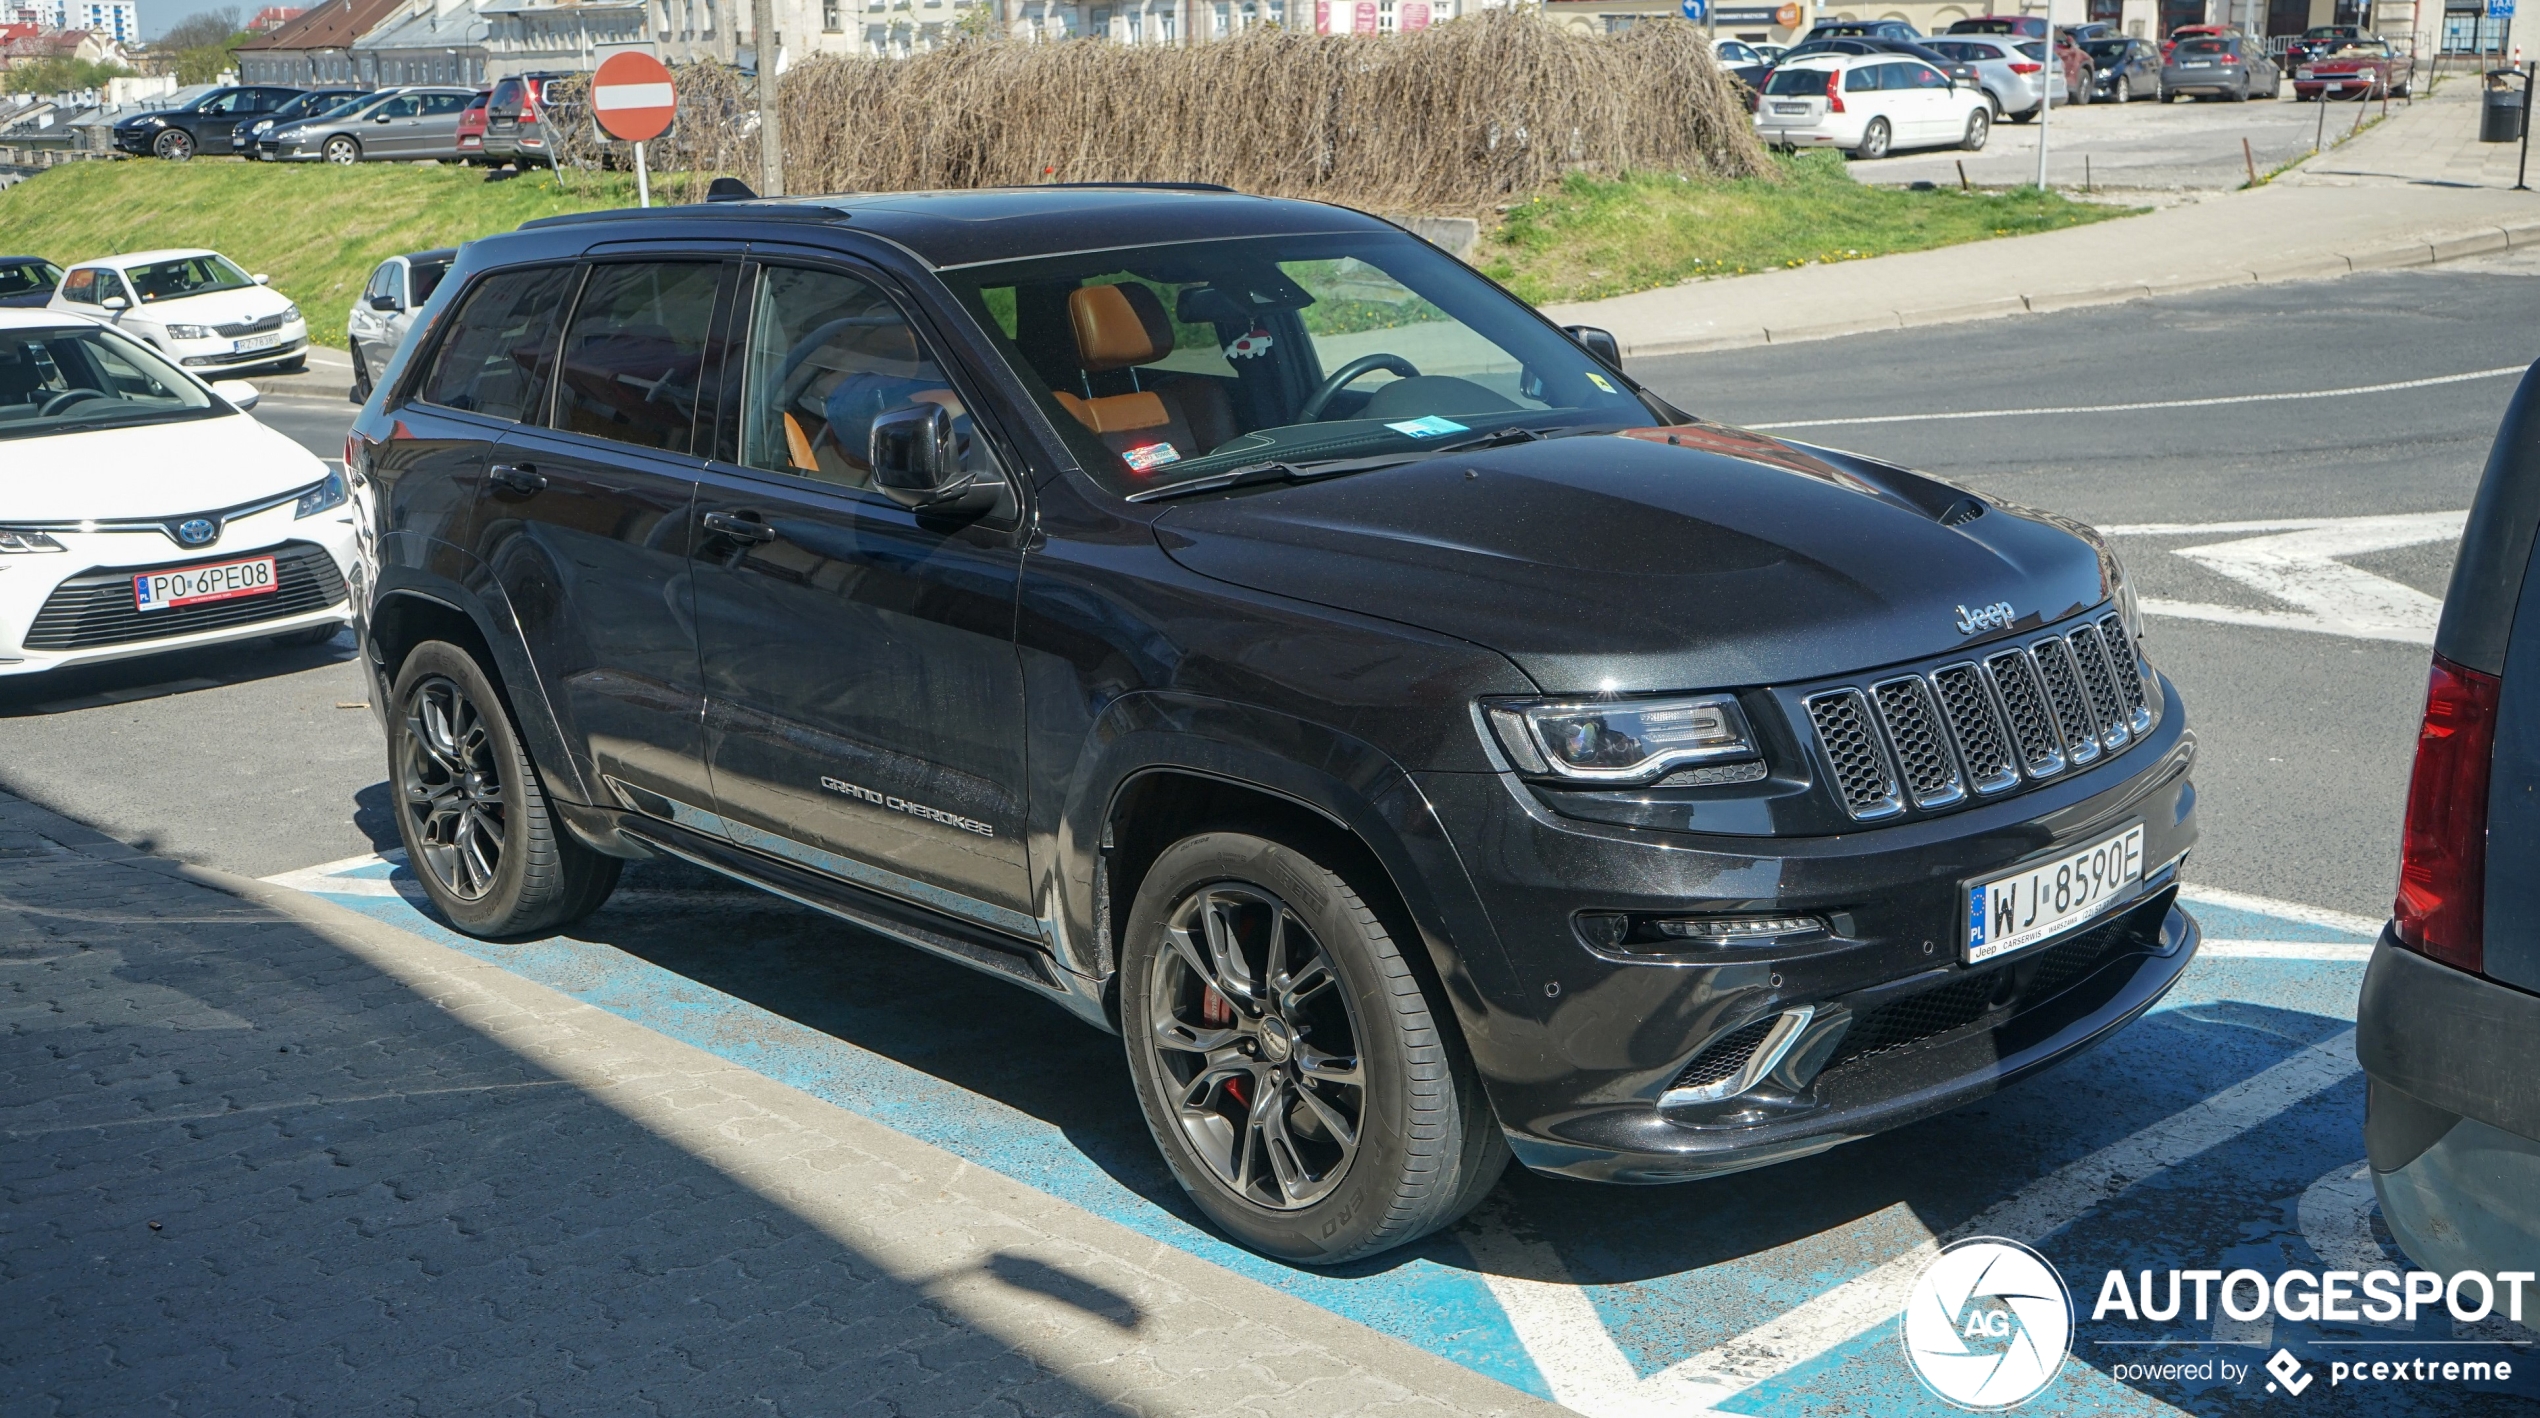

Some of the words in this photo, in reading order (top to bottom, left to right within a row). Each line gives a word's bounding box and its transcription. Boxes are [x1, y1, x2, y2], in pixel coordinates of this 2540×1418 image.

[240, 341, 252, 350] RZ
[140, 593, 149, 601] PL
[154, 574, 186, 600] PO
[196, 562, 268, 594] 6PE08
[1955, 601, 2015, 634] Jeep
[820, 775, 883, 805] GRAND
[886, 795, 994, 838] CHEROKEE
[1993, 874, 2039, 939] WJ
[2055, 829, 2140, 915] 8590E
[1970, 927, 1984, 943] PL
[1975, 944, 1997, 958] Jeep
[2002, 929, 2042, 950] CARSERWIS
[2048, 915, 2078, 934] WARSZAWA
